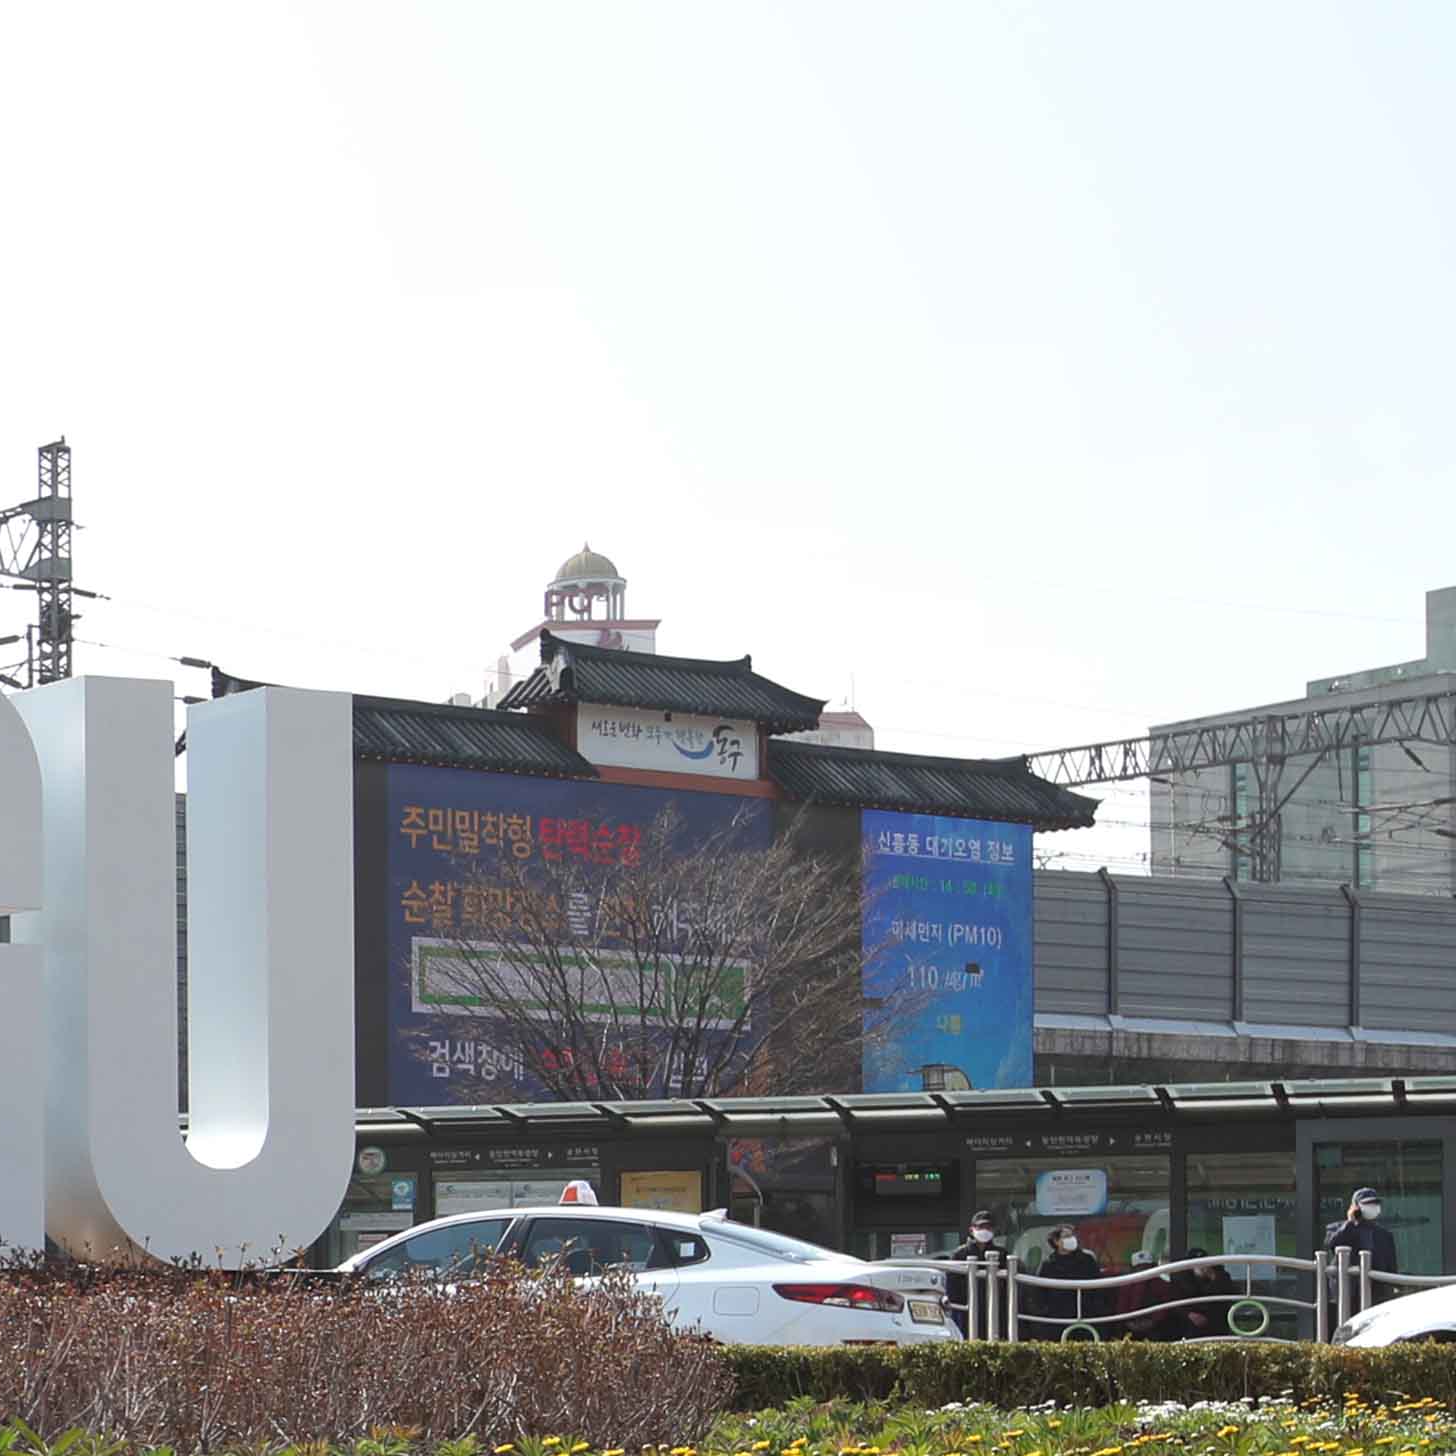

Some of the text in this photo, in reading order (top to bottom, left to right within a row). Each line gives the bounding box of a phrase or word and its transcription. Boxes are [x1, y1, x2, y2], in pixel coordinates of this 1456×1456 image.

[712, 724, 745, 772] 동구
[400, 804, 532, 859] 주민밀착형
[878, 831, 1015, 864] 신흥동 대기오염 정보
[891, 919, 1002, 949] 미세먼지 (PM10)
[908, 965, 939, 990] 110
